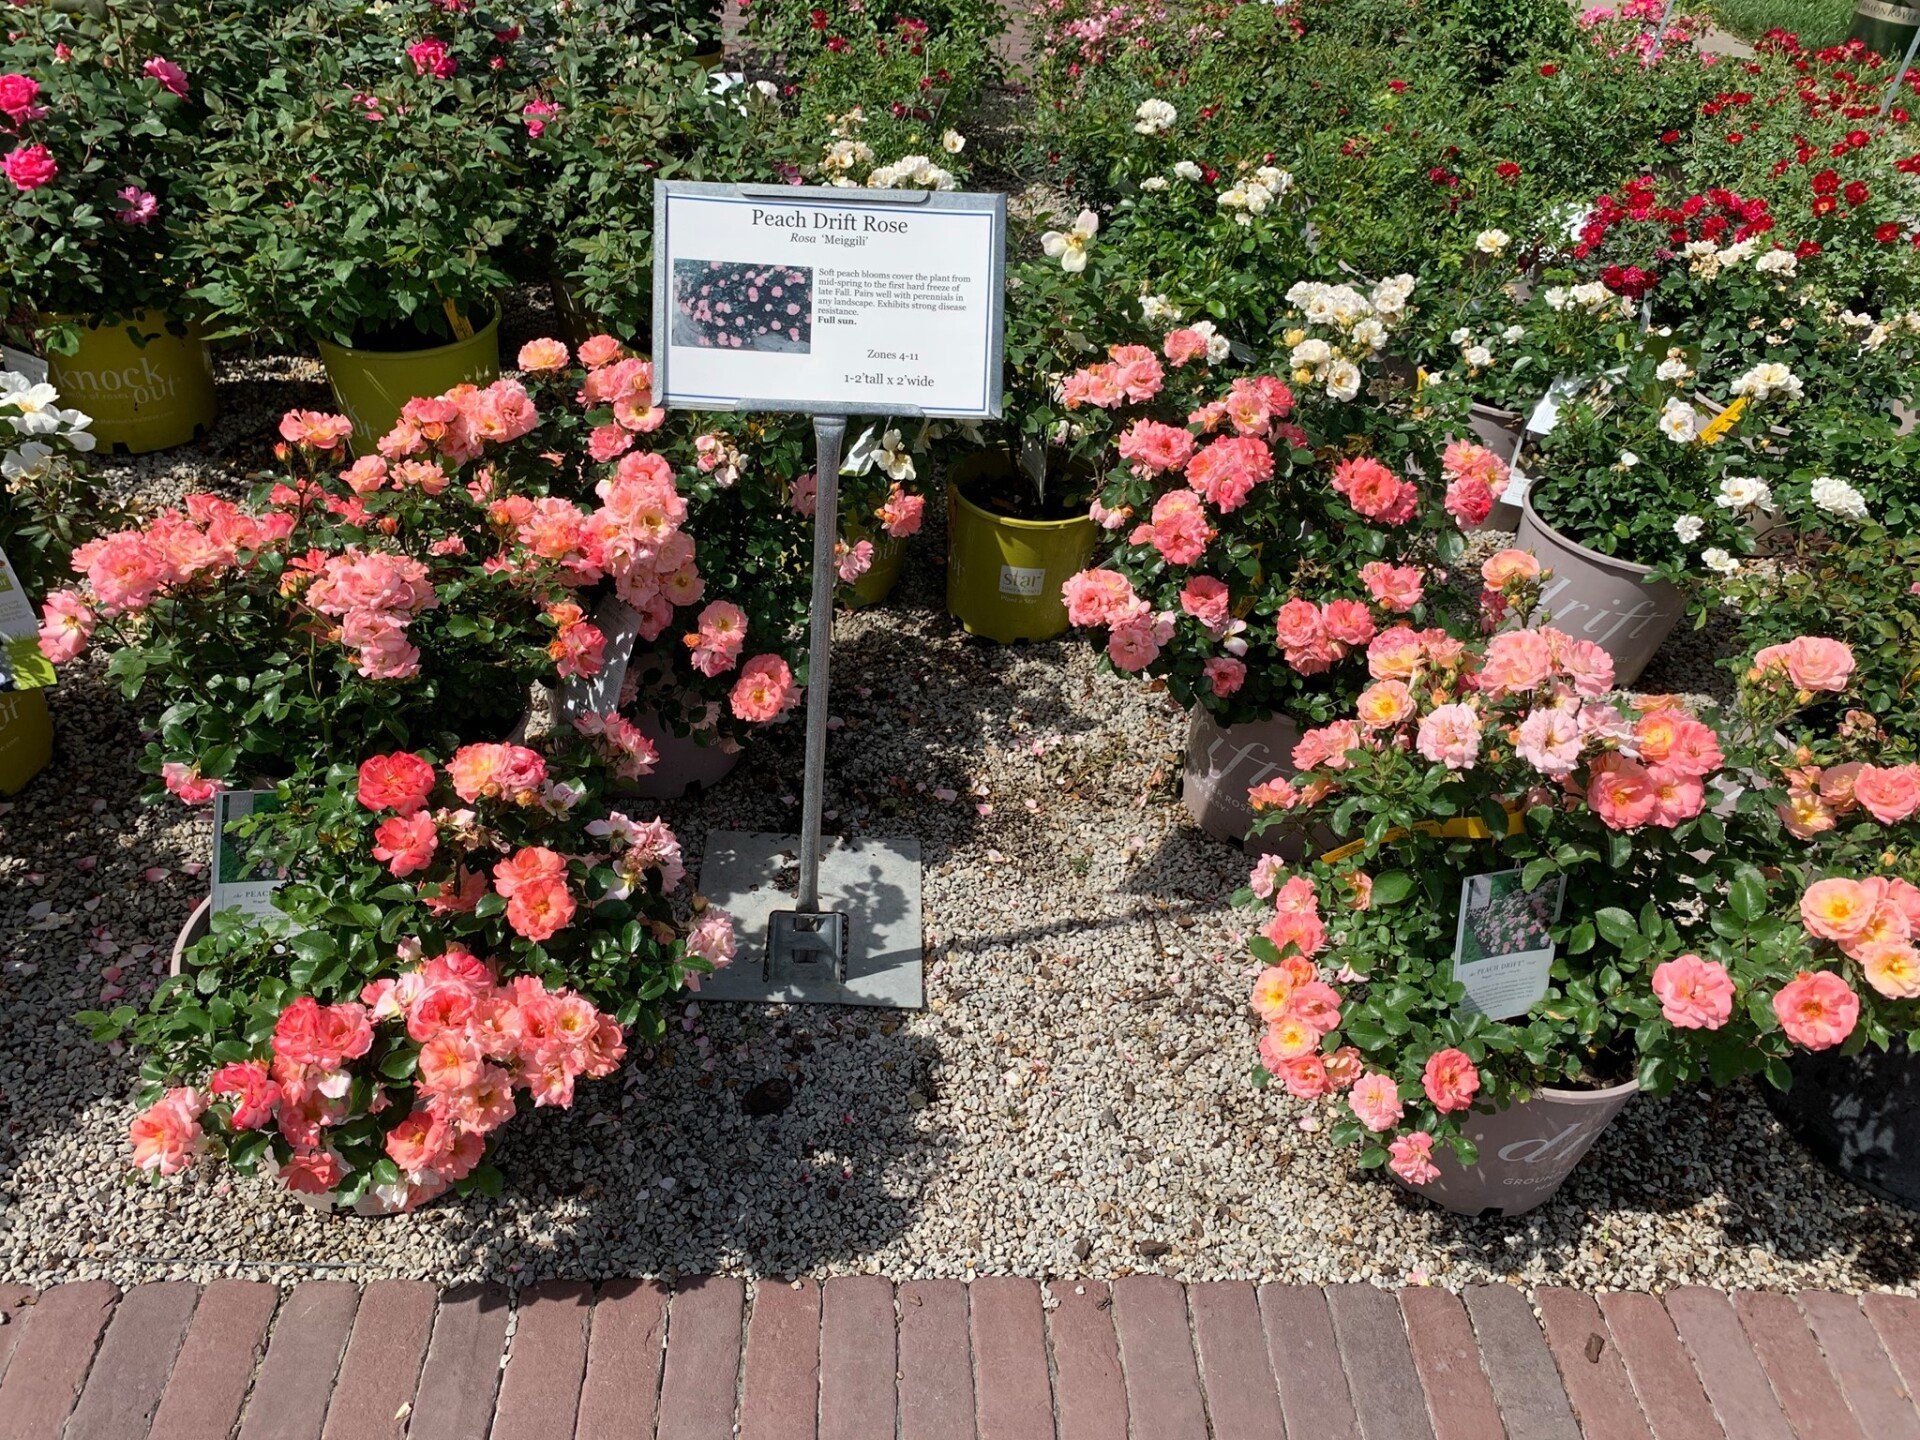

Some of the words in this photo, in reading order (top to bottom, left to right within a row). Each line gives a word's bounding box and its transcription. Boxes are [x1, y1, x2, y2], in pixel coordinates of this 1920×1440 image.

[752, 208, 806, 228] Peach
[813, 211, 857, 231] Drift
[863, 214, 908, 234] Rose
[790, 233, 816, 244] Rosa
[818, 267, 835, 276] Soft
[836, 269, 860, 279] peach
[861, 270, 891, 279] blooms
[915, 273, 928, 281] the
[929, 274, 950, 283] plant
[951, 275, 971, 283] from
[818, 278, 863, 289] mid-spring
[874, 280, 887, 289] the
[888, 281, 905, 290] first
[906, 282, 925, 291] hard
[926, 283, 950, 292] freeze
[951, 284, 961, 292] of
[818, 287, 833, 296] late
[854, 289, 874, 298] Pairs
[875, 290, 892, 299] well
[893, 291, 911, 300] with
[912, 293, 954, 302] perennials
[955, 293, 964, 302] in
[817, 298, 832, 307] any
[834, 297, 875, 308] landscape.
[877, 299, 910, 310] Exhibits
[911, 302, 937, 312] strong
[937, 302, 967, 312] disease
[817, 307, 859, 316] resistance.
[817, 315, 836, 324] Full
[867, 349, 897, 360] Zones
[898, 352, 919, 362] 4-11
[51, 357, 164, 391] knock
[886, 377, 894, 385] x
[133, 373, 177, 404] out
[1003, 569, 1041, 588] star
